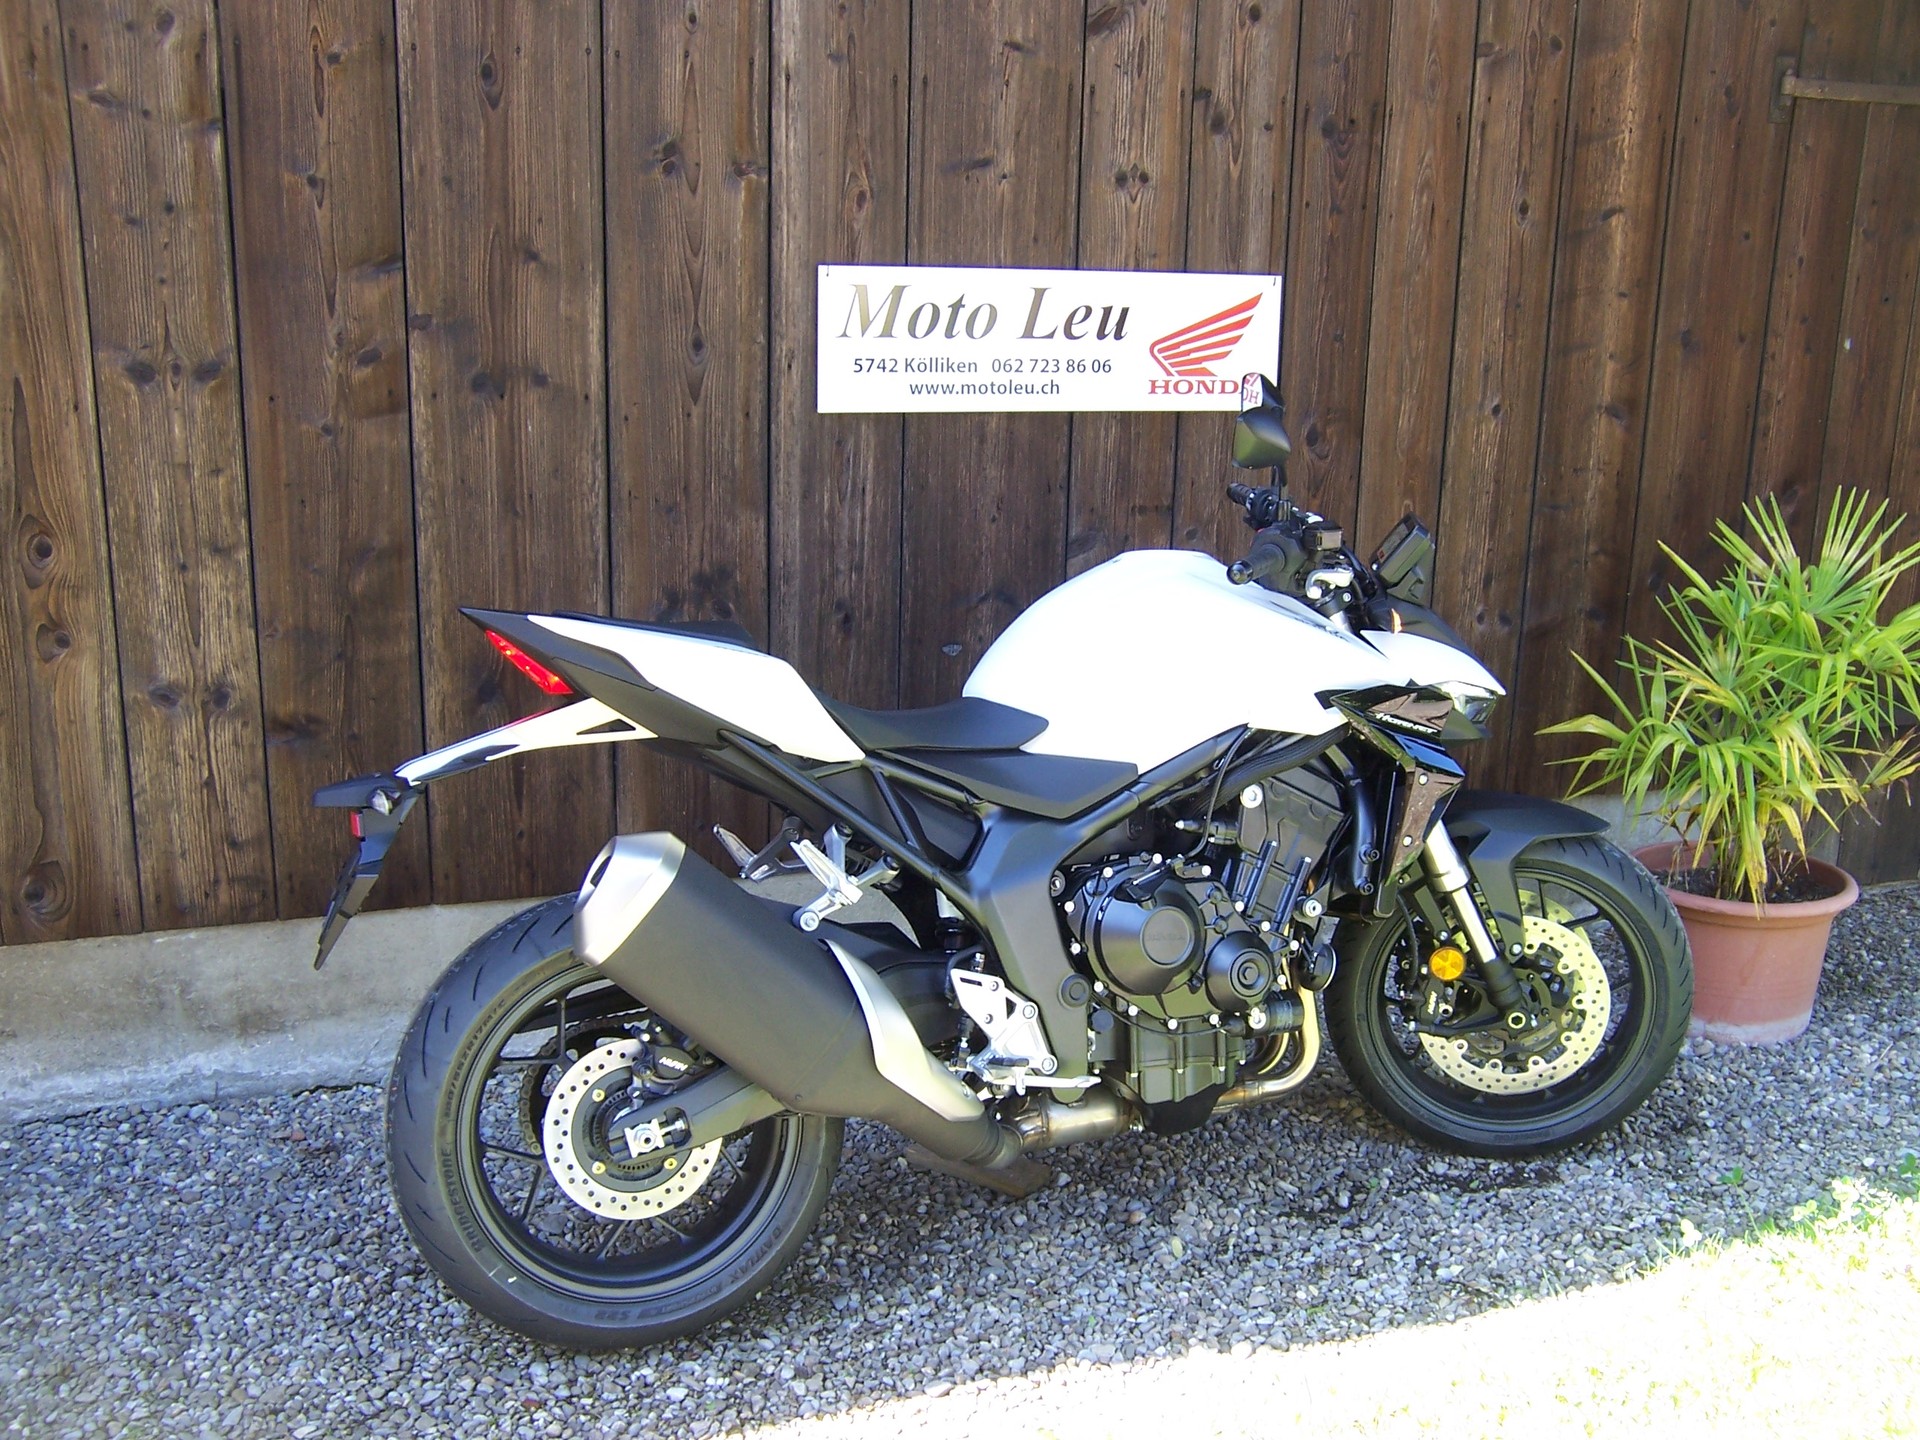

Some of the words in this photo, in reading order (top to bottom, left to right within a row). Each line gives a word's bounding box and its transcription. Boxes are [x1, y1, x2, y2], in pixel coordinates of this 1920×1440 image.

[836, 284, 998, 340] Moto
[1017, 287, 1130, 341] Leu
[853, 358, 899, 374] 5742
[904, 357, 978, 374] Kölliken
[991, 358, 1024, 374] 062
[1029, 359, 1060, 374] 723
[1066, 359, 1087, 374] 86
[1092, 359, 1112, 374] 06
[909, 379, 1060, 395] www.motoleu.ch
[1148, 379, 1241, 395] HOND
[441, 1142, 485, 1253] BRIDGESTONE
